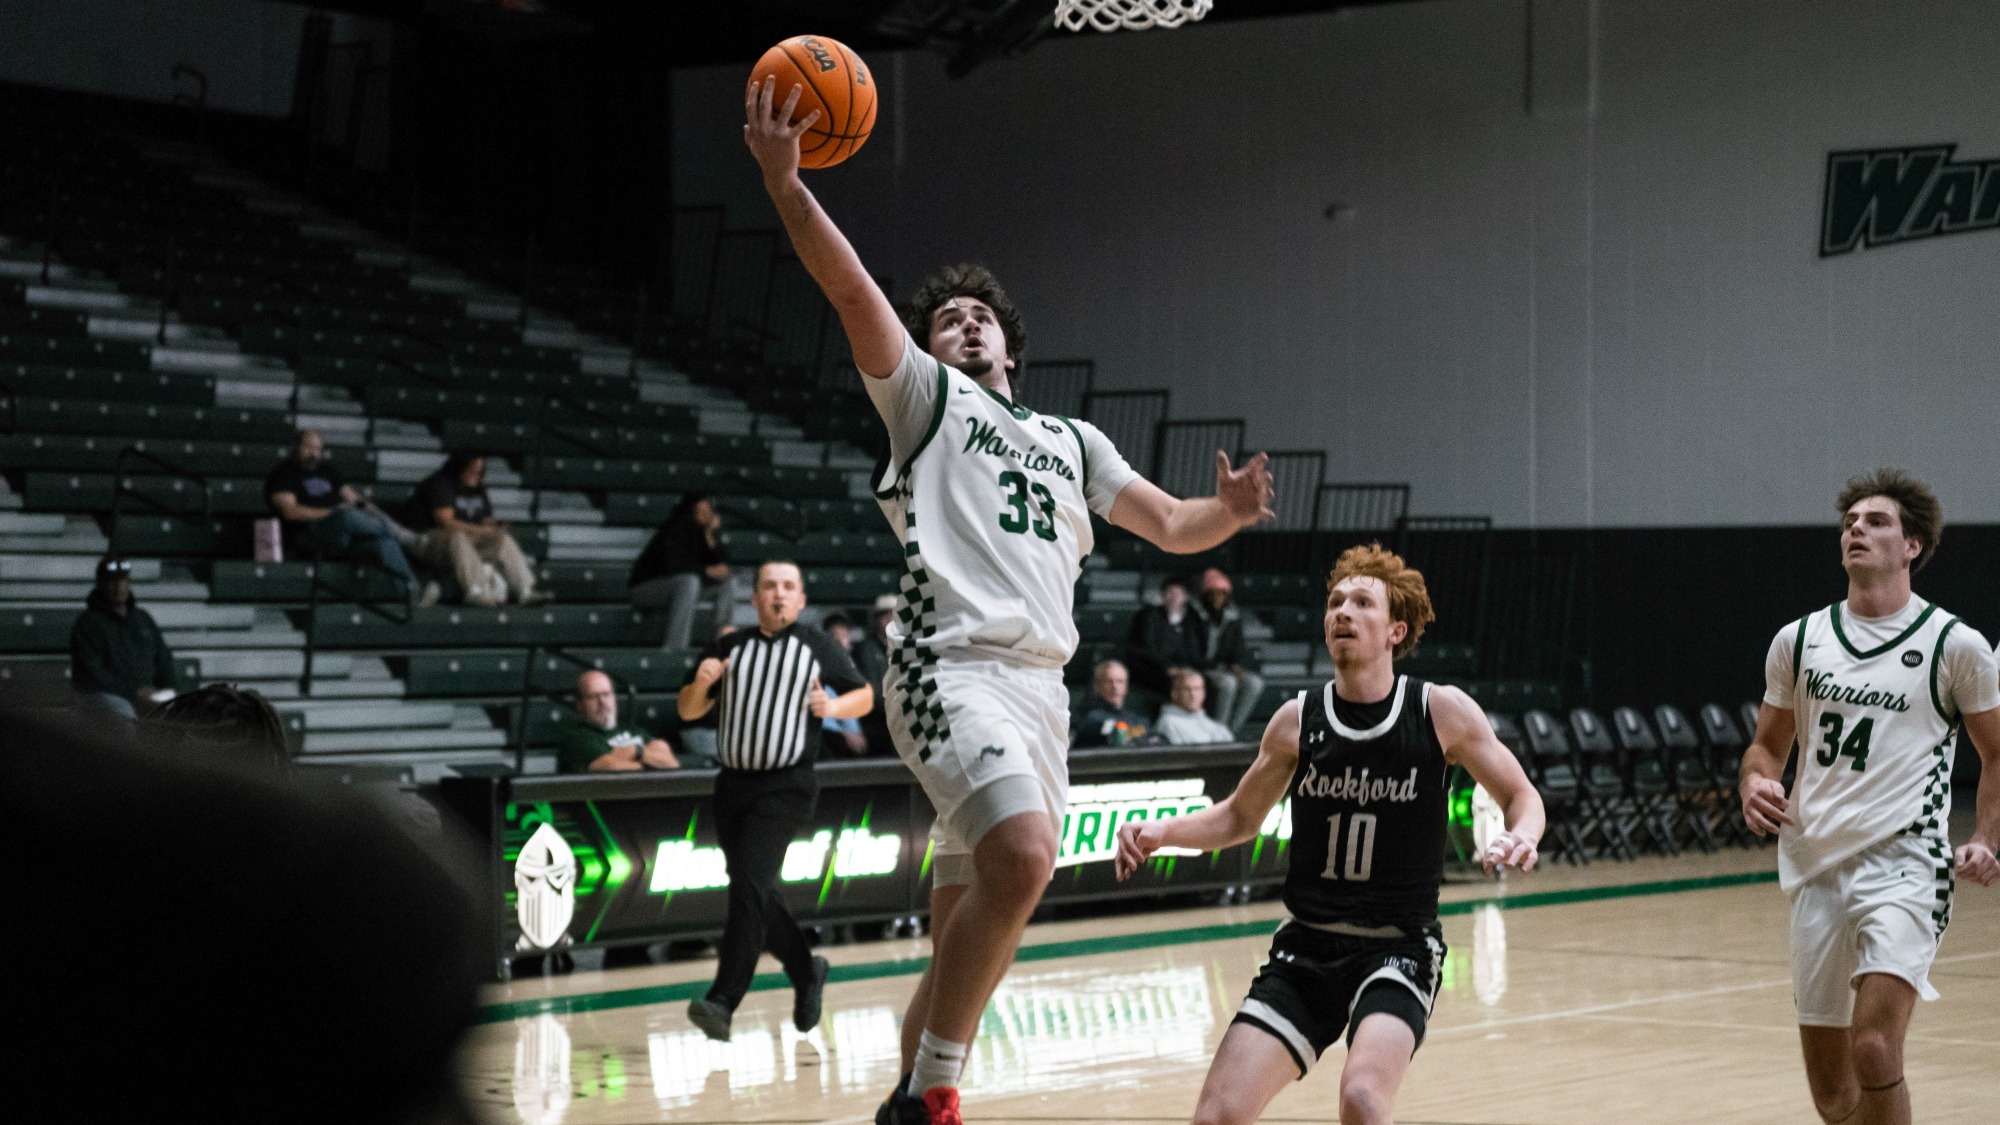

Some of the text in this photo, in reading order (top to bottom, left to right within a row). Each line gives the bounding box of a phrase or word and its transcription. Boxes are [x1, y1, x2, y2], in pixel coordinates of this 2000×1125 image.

[998, 470, 1058, 542] 33
[1804, 668, 1911, 713] Warriors
[1816, 711, 1875, 773] 34
[1297, 762, 1418, 807] Rockford
[834, 827, 901, 877] the
[1320, 812, 1377, 882] 10
